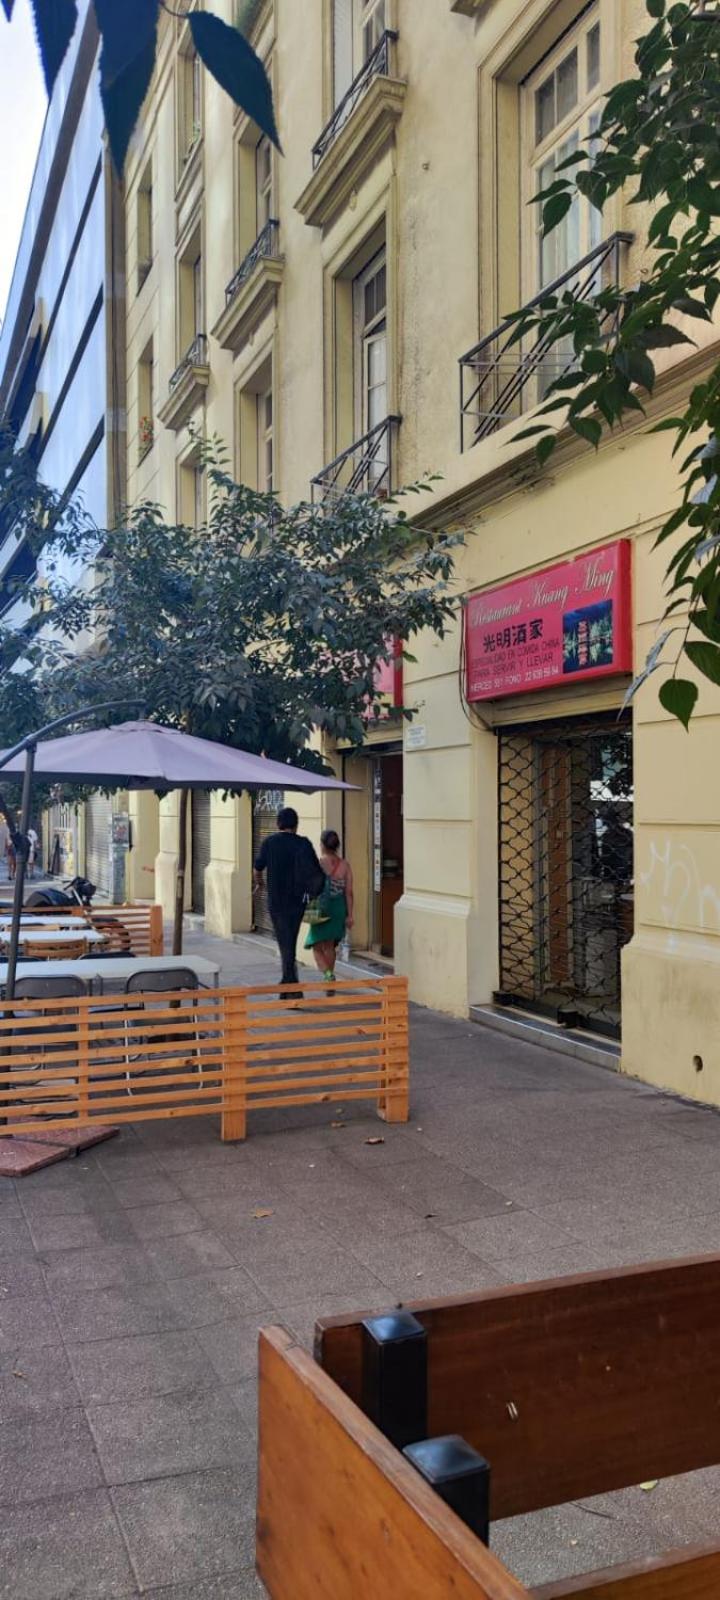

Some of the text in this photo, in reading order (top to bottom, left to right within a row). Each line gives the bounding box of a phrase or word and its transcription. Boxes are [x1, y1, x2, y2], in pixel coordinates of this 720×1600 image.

[471, 599, 522, 629] Restaurant
[575, 553, 615, 596] Ming
[483, 618, 544, 653] 光明酒家
[507, 648, 516, 660] EN
[517, 642, 540, 657] COMIDA
[541, 638, 560, 650] CHINA
[492, 661, 516, 676] SERVIR
[526, 652, 554, 668] LLEVAR
